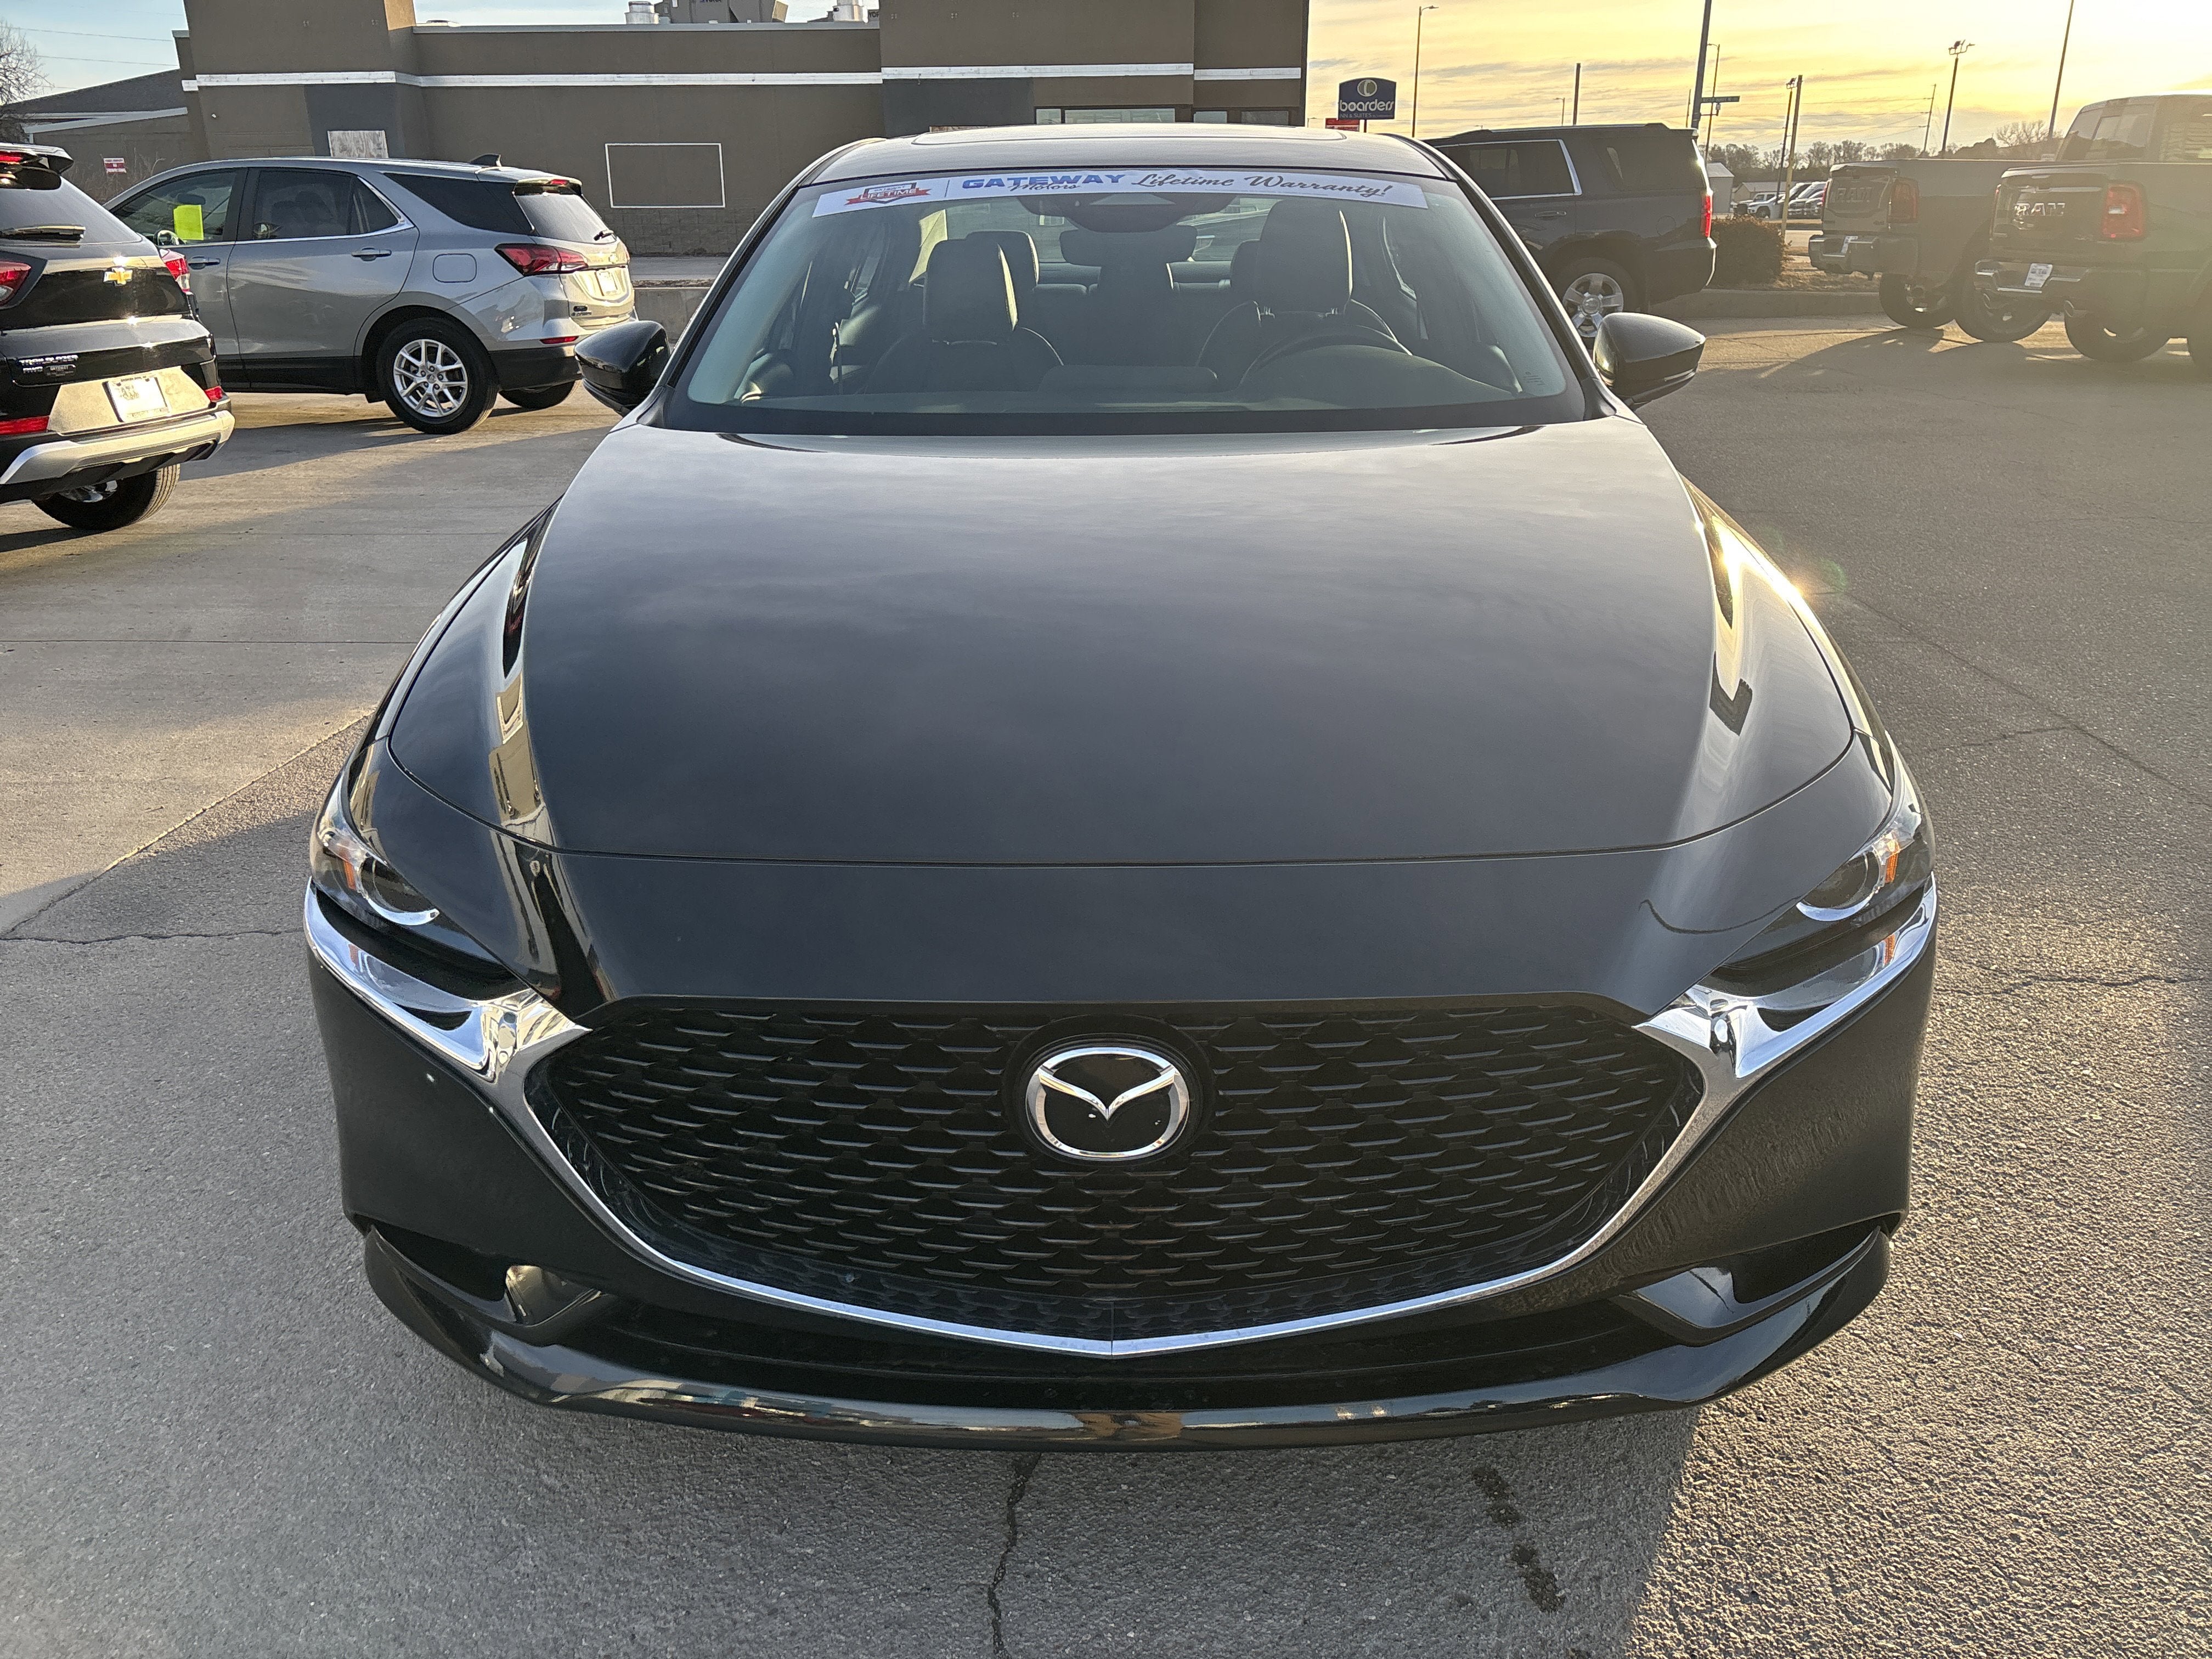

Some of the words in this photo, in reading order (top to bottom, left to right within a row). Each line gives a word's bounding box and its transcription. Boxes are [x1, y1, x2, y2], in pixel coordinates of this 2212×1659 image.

[1340, 99, 1394, 111] boarders
[962, 174, 1126, 189] GATEWAY
[1007, 182, 1081, 191] Motors
[1131, 173, 1234, 188] Lifetime
[1244, 175, 1393, 198] Warranty!
[860, 188, 917, 200] LIFETIME
